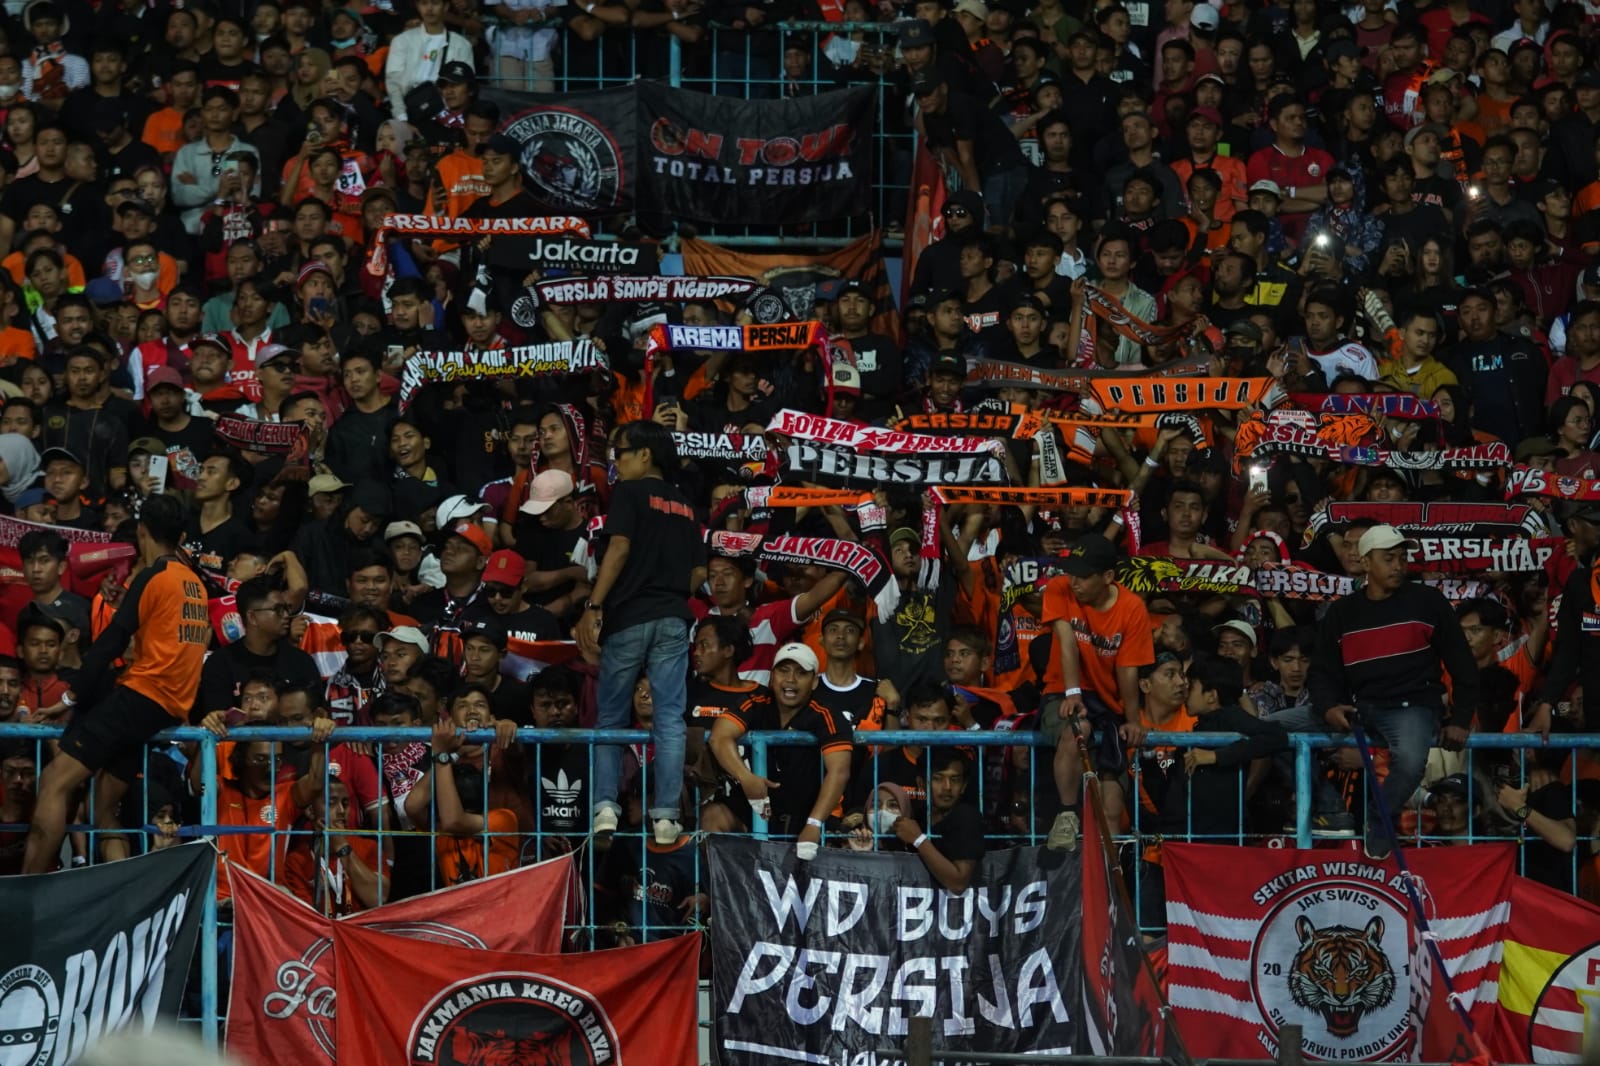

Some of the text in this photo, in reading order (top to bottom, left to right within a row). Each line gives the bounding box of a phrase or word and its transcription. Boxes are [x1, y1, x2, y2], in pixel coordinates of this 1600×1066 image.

[508, 116, 549, 140] ERSIJA
[653, 156, 854, 185] TOTAL PERSIJA
[385, 214, 591, 237] ERSIJA JAKARTA
[528, 238, 640, 265] Jakarta
[542, 281, 609, 302] PERSIJA
[614, 279, 669, 299] SAMPE
[672, 327, 809, 349] AREMA PERSIJA
[1108, 381, 1250, 405] PERSIJA
[782, 412, 857, 441] FORZA
[908, 414, 1013, 431] ERSIJA
[672, 432, 734, 451] RSIJA
[788, 445, 1002, 483] PERSIJA
[759, 552, 811, 565] CHAMPIONS
[763, 535, 883, 587] JAKARTA
[1486, 547, 1553, 572] JUAR
[1256, 570, 1354, 596] ERSIJA
[542, 804, 580, 818] akart
[1252, 864, 1318, 907] SEKITAR
[1322, 862, 1387, 884] WISMA
[757, 869, 1048, 942] WD BOYS
[1297, 889, 1380, 912] JAK SWISS
[1263, 963, 1282, 976] 20
[726, 941, 1073, 1037] PERSIJA
[416, 981, 613, 1063] JAKMANIA KREO RAYA
[1301, 1036, 1338, 1059] ORWIL
[1341, 1035, 1390, 1059] PONDOK
